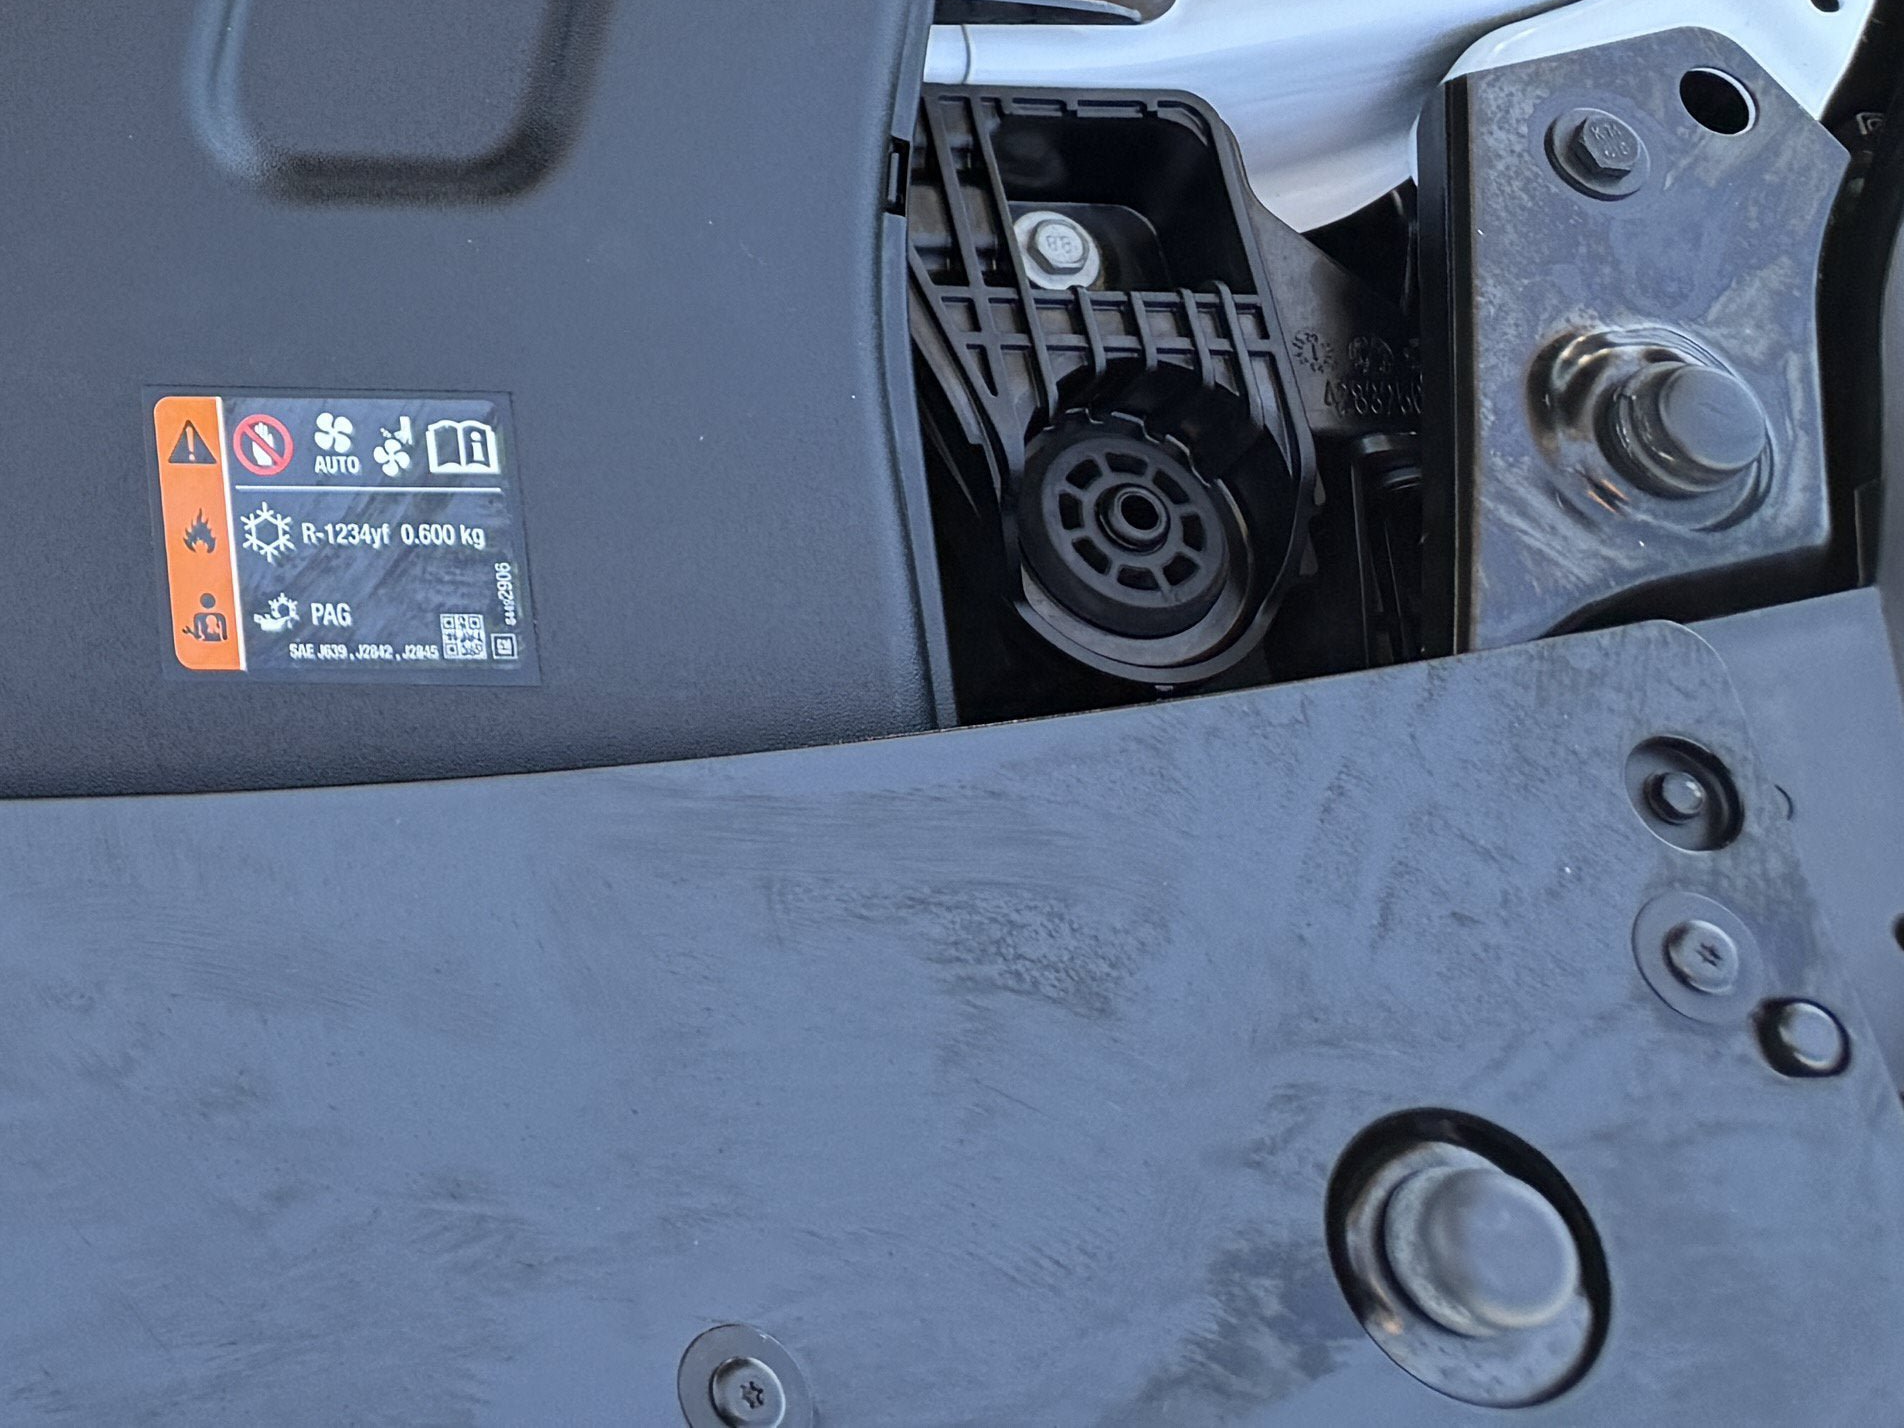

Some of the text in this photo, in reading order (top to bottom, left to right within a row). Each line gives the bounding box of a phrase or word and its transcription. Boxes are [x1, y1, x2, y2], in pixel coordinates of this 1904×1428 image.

[314, 454, 360, 476] AUTO
[302, 522, 486, 550] R-1234yf 0.600 kg
[310, 601, 352, 628] PAG
[288, 642, 316, 660] SAE
